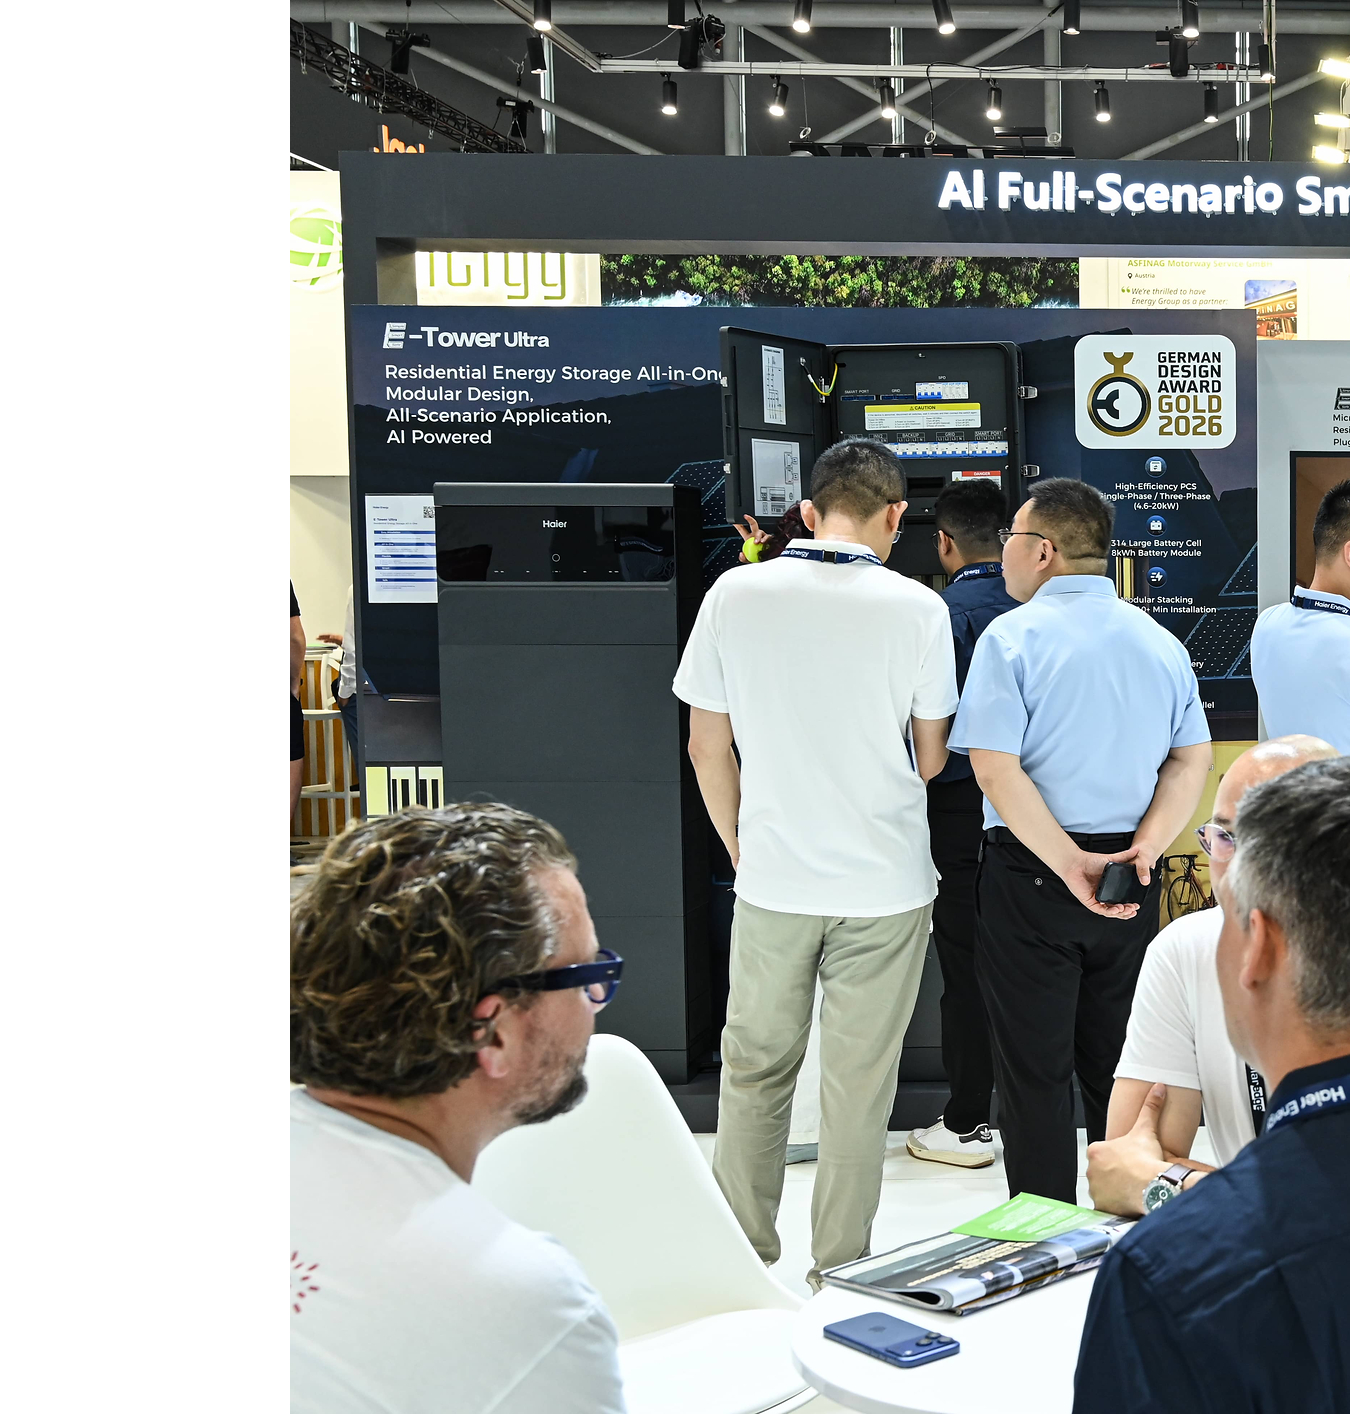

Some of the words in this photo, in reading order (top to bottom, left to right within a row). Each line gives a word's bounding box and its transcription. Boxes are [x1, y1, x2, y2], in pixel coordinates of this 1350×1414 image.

[938, 170, 985, 210] AI
[999, 171, 1284, 215] Full-Scenario
[1127, 259, 1165, 267] ASFINAG
[1167, 259, 1211, 269] Motorway
[383, 322, 501, 349] E-Tower
[504, 331, 550, 348] Ultra
[1157, 351, 1222, 363] GERMAN
[385, 364, 487, 381] Residential
[493, 365, 556, 383] Energy
[561, 365, 632, 383] Storage
[1157, 364, 1222, 378] DESIGN
[1157, 379, 1222, 393] AWARD
[386, 386, 462, 401] Modular
[468, 387, 534, 404] Design,
[1158, 394, 1222, 414] GOLD
[386, 408, 497, 423] All-Scenario
[501, 408, 612, 426] Application,
[1158, 415, 1223, 436] 2026
[387, 429, 405, 444] AI
[412, 429, 492, 444] Powered
[1115, 482, 1179, 491] High-Efficiency
[1180, 482, 1197, 490] PCS
[1160, 492, 1211, 500] Three-Phase
[542, 519, 568, 529] Haier
[1128, 539, 1152, 549] Large
[1153, 539, 1184, 549] Battery
[1138, 549, 1169, 558] Battery
[1170, 549, 1202, 557] Module
[1157, 596, 1193, 605] Stacking
[1314, 600, 1330, 608] Haier
[1300, 1086, 1346, 1108] Haier
